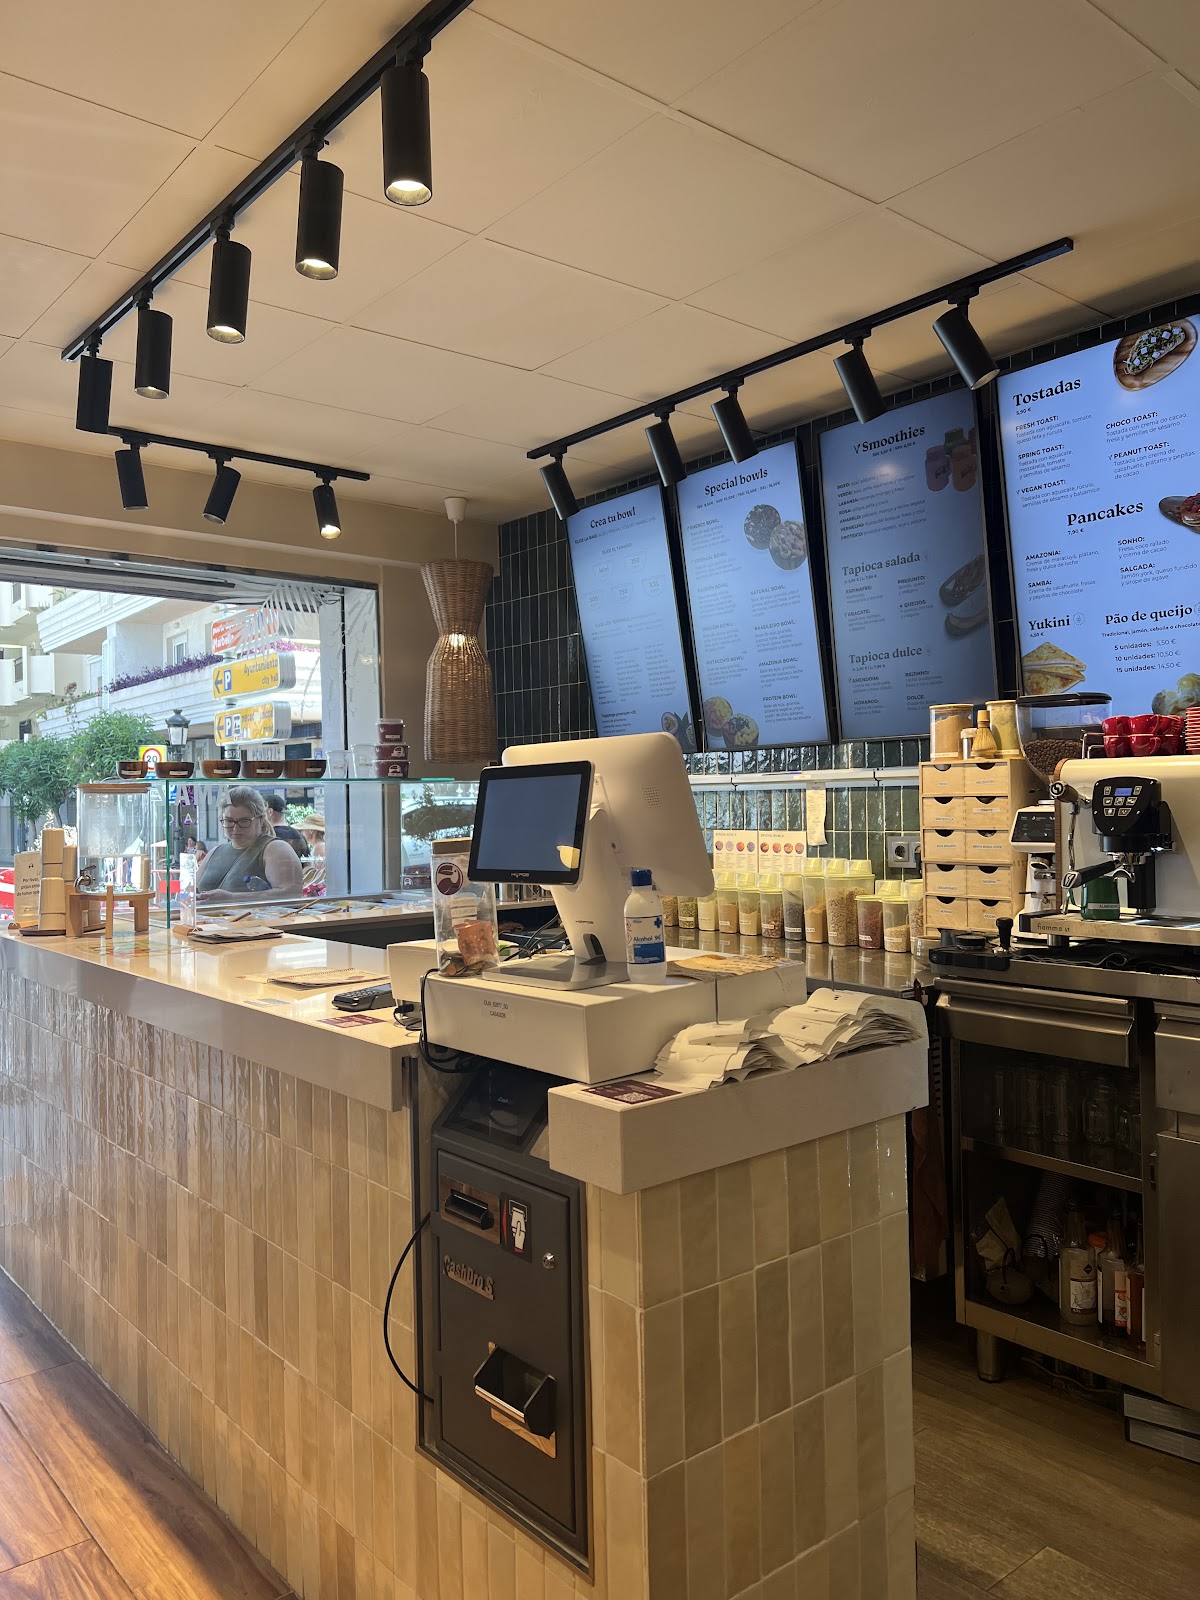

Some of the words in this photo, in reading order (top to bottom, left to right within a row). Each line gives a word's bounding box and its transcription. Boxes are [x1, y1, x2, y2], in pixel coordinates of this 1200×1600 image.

[1013, 380, 1081, 406] Tostadas
[1016, 422, 1035, 432] FRESH
[1037, 416, 1059, 426] TOAST:
[1106, 419, 1131, 430] CHOCO
[1132, 412, 1158, 423] TOAST:
[862, 427, 925, 452] Smoothies
[1018, 450, 1041, 460] SPRING
[1042, 445, 1064, 454] TOAST:
[1114, 448, 1142, 459] PEANUT
[1144, 442, 1170, 452] TOAST:
[705, 477, 738, 497] Special
[739, 469, 768, 485] bowls
[1021, 485, 1043, 494] VEGAN
[1044, 480, 1065, 489] TOAST:
[590, 518, 607, 529] Crea
[608, 515, 616, 523] tu
[616, 506, 637, 521] bowl
[1067, 501, 1144, 526] Pancakes
[1118, 537, 1145, 546] SONHO:
[1026, 551, 1061, 561] AMAZONIA:
[842, 562, 883, 577] Tapioca
[885, 553, 920, 568] salada
[1120, 564, 1155, 573] SALGADA:
[1029, 616, 1070, 631] Yukini
[1106, 614, 1128, 625] Pão
[1131, 612, 1147, 622] de
[1150, 606, 1193, 620] queijo
[849, 652, 890, 666] Tapioca
[892, 647, 922, 659] dulce
[244, 659, 278, 676] Ayuntamiento
[1124, 665, 1156, 673] unidades:
[270, 673, 278, 683] hall
[146, 755, 157, 763] 20
[1037, 922, 1062, 932] fiamma
